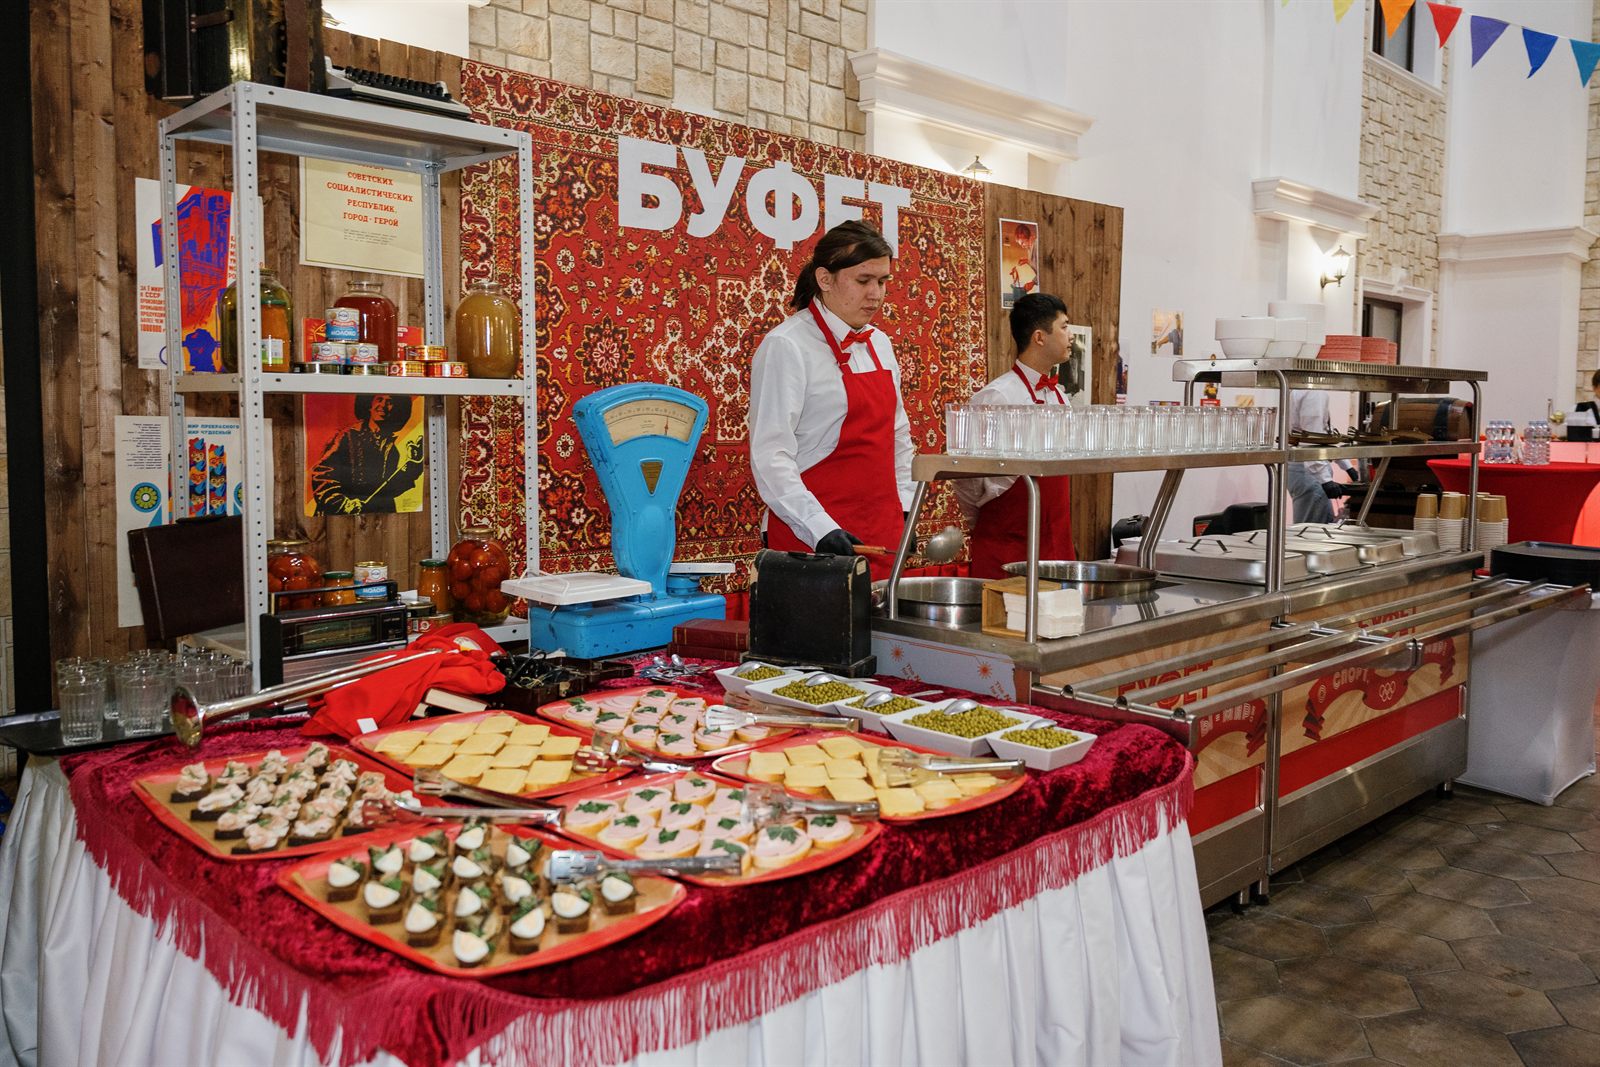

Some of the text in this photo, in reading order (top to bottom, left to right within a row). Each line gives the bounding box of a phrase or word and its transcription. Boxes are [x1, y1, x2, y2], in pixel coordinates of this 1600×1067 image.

[347, 171, 393, 186] СОВЕТСКИХ
[326, 181, 413, 202] СОЦИАЛИСТИЧЕСКИХ
[618, 135, 911, 259] БУФЕТ
